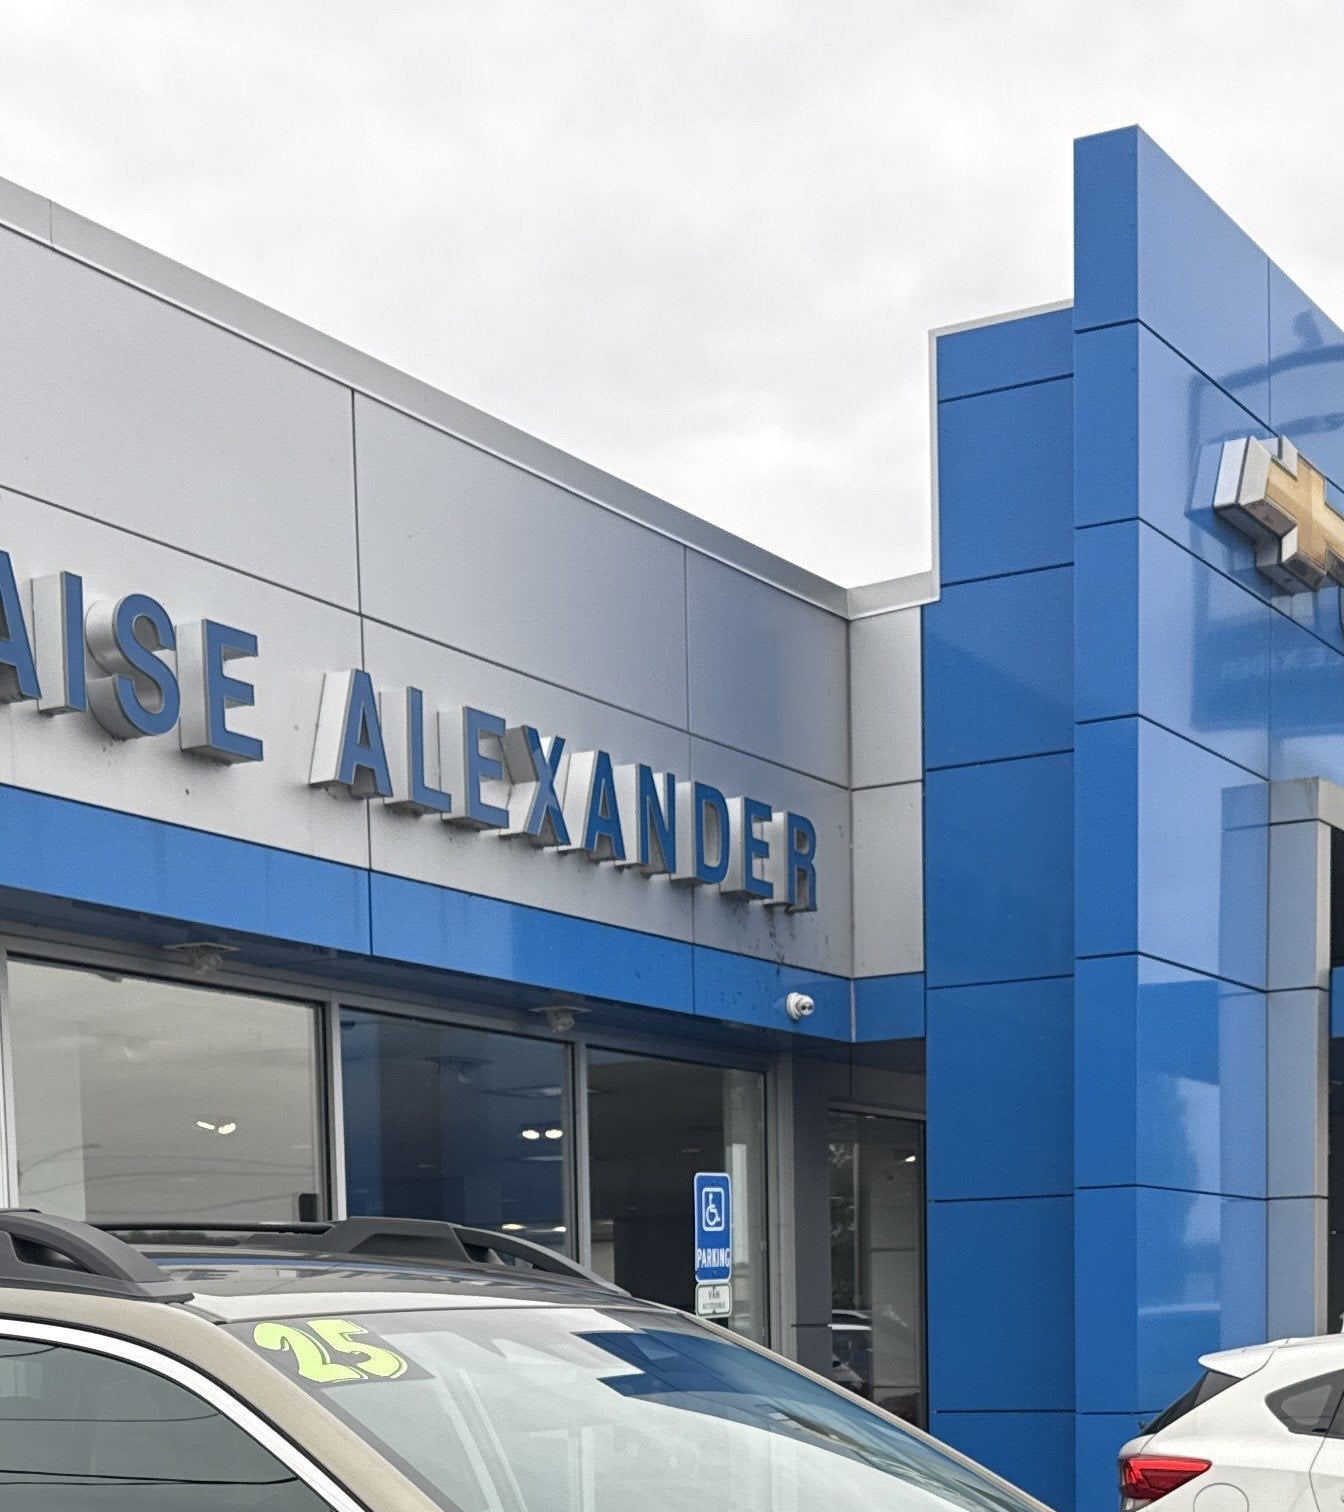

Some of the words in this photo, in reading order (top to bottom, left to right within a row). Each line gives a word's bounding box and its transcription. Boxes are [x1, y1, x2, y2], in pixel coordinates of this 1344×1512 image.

[311, 668, 817, 913] ALEXANDER
[697, 1248, 731, 1268] PARKING
[254, 1319, 408, 1383] 25
